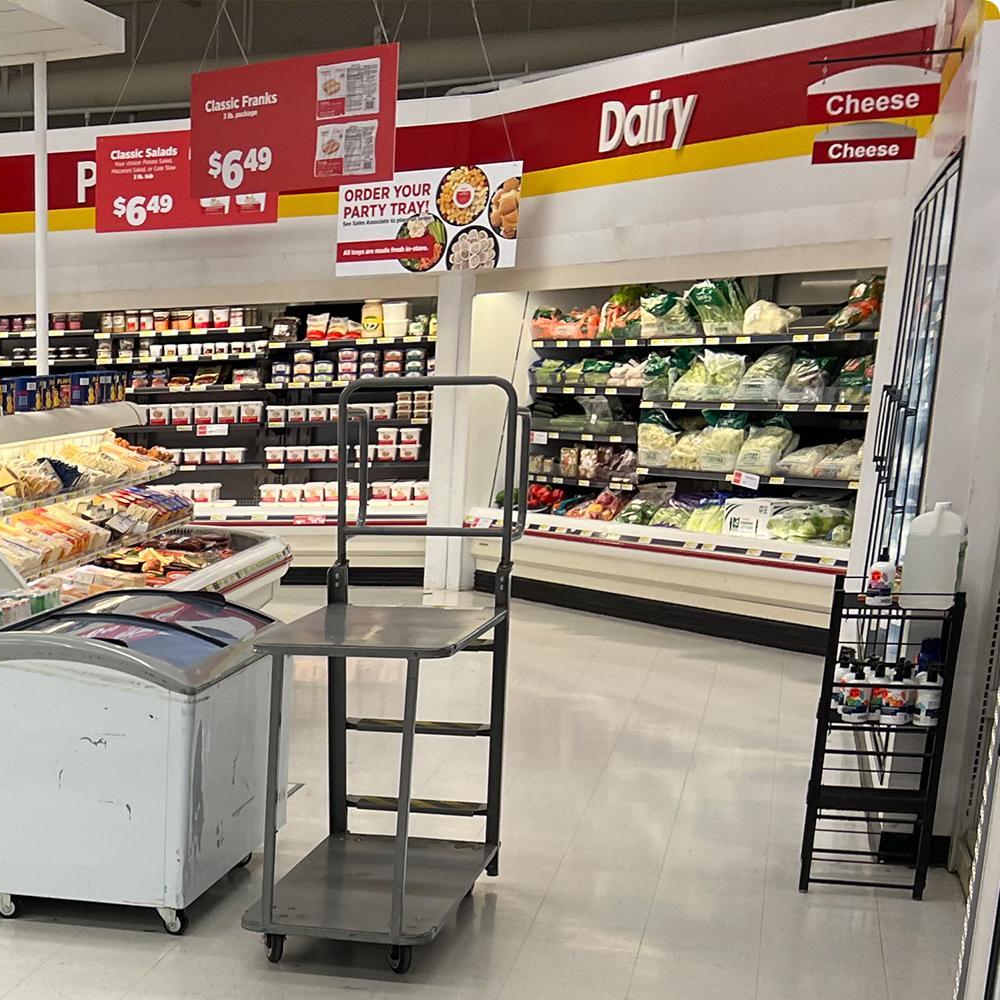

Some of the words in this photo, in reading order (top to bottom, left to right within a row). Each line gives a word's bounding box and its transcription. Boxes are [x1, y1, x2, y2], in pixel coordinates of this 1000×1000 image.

[205, 97, 239, 112] Classic
[242, 91, 277, 107] Franks
[826, 92, 920, 115] Cheese
[598, 89, 698, 152] Dairy
[110, 149, 144, 160] Classic
[145, 146, 178, 158] Salads
[828, 142, 899, 159] Cheese
[344, 186, 390, 202] ORDER
[394, 183, 431, 198] YOUR
[343, 203, 386, 219] PARTY
[390, 200, 429, 216] TRAY!
